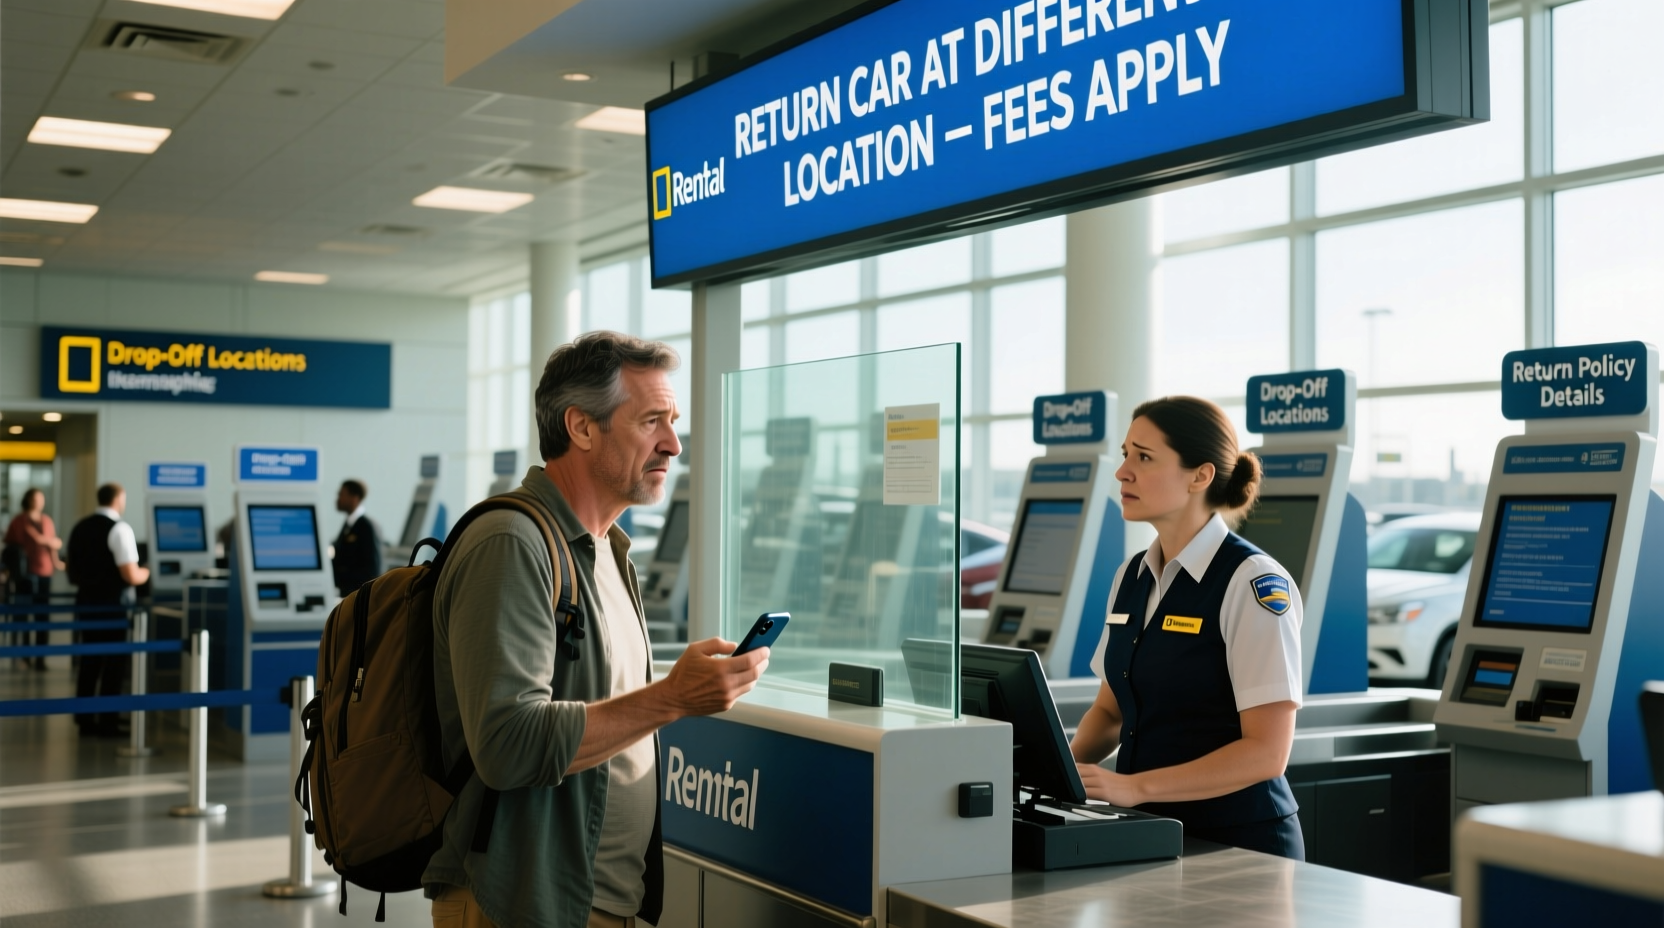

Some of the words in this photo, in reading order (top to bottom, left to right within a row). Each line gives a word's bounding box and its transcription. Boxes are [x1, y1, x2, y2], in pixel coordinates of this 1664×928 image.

[735, 75, 841, 159] RETURN
[849, 50, 913, 118] CAR
[920, 28, 965, 95] AT
[974, 0, 1201, 76] DIFFER
[783, 114, 934, 207] LOCATION
[983, 69, 1075, 150] FEES
[1084, 19, 1231, 122] APPLY
[672, 156, 725, 207] Rental
[107, 340, 205, 371] Drop-Off
[207, 345, 307, 372] Locations
[1512, 361, 1573, 383] Return
[1578, 353, 1636, 382] Policy
[1260, 376, 1329, 405] Drop-Off
[1540, 382, 1605, 408] Details
[1260, 402, 1330, 425] Locations
